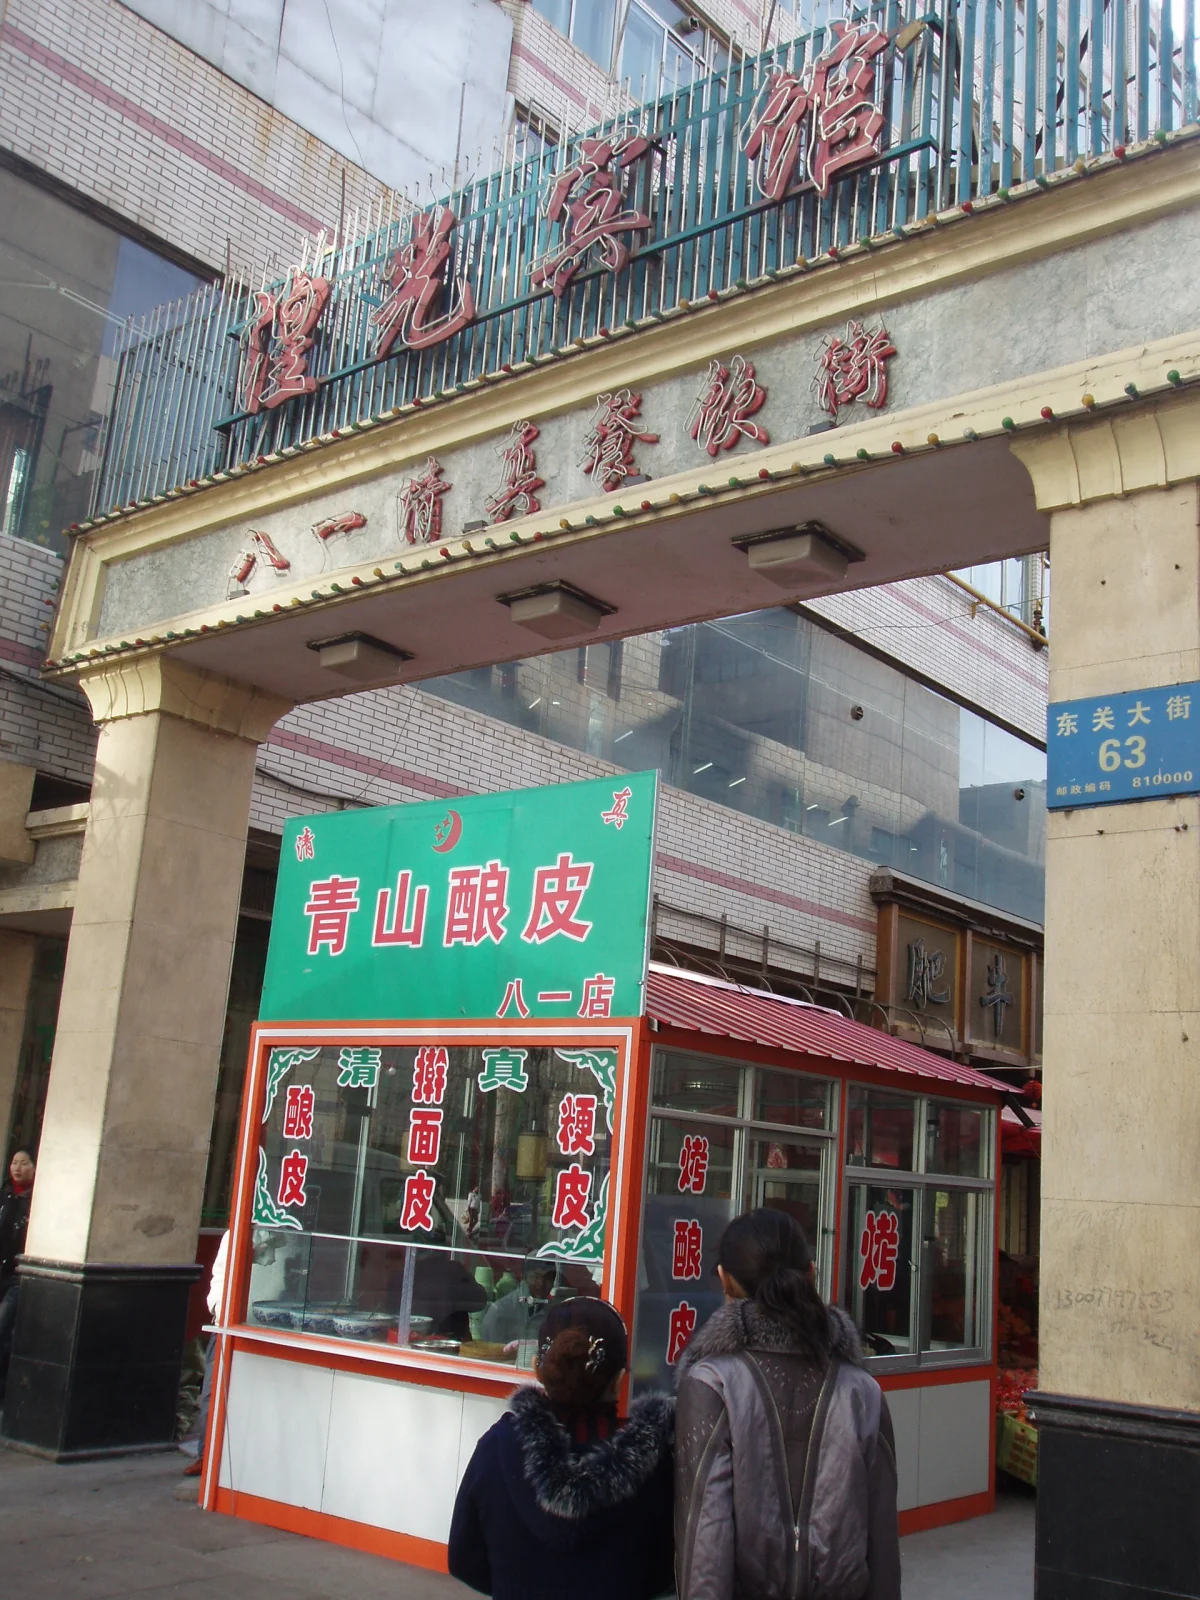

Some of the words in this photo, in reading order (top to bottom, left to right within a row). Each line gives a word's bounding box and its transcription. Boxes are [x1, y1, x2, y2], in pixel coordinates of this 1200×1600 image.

[1056, 695, 1192, 736] 东关大街
[1098, 736, 1147, 772] 63
[1056, 780, 1111, 796] 邮政编码
[1132, 771, 1193, 788] 810000
[296, 827, 316, 861] 清
[602, 786, 632, 829] 真
[304, 853, 594, 956] 青山酿皮
[496, 973, 615, 1018] 八一店
[904, 937, 1015, 1037] 肥羊
[337, 1047, 381, 1088] 清
[478, 1047, 528, 1092] 真
[277, 1084, 315, 1207] 酿皮
[401, 1047, 449, 1231] 擀面皮
[666, 1134, 709, 1365] 烤酿皮
[861, 1210, 899, 1291] 烤
